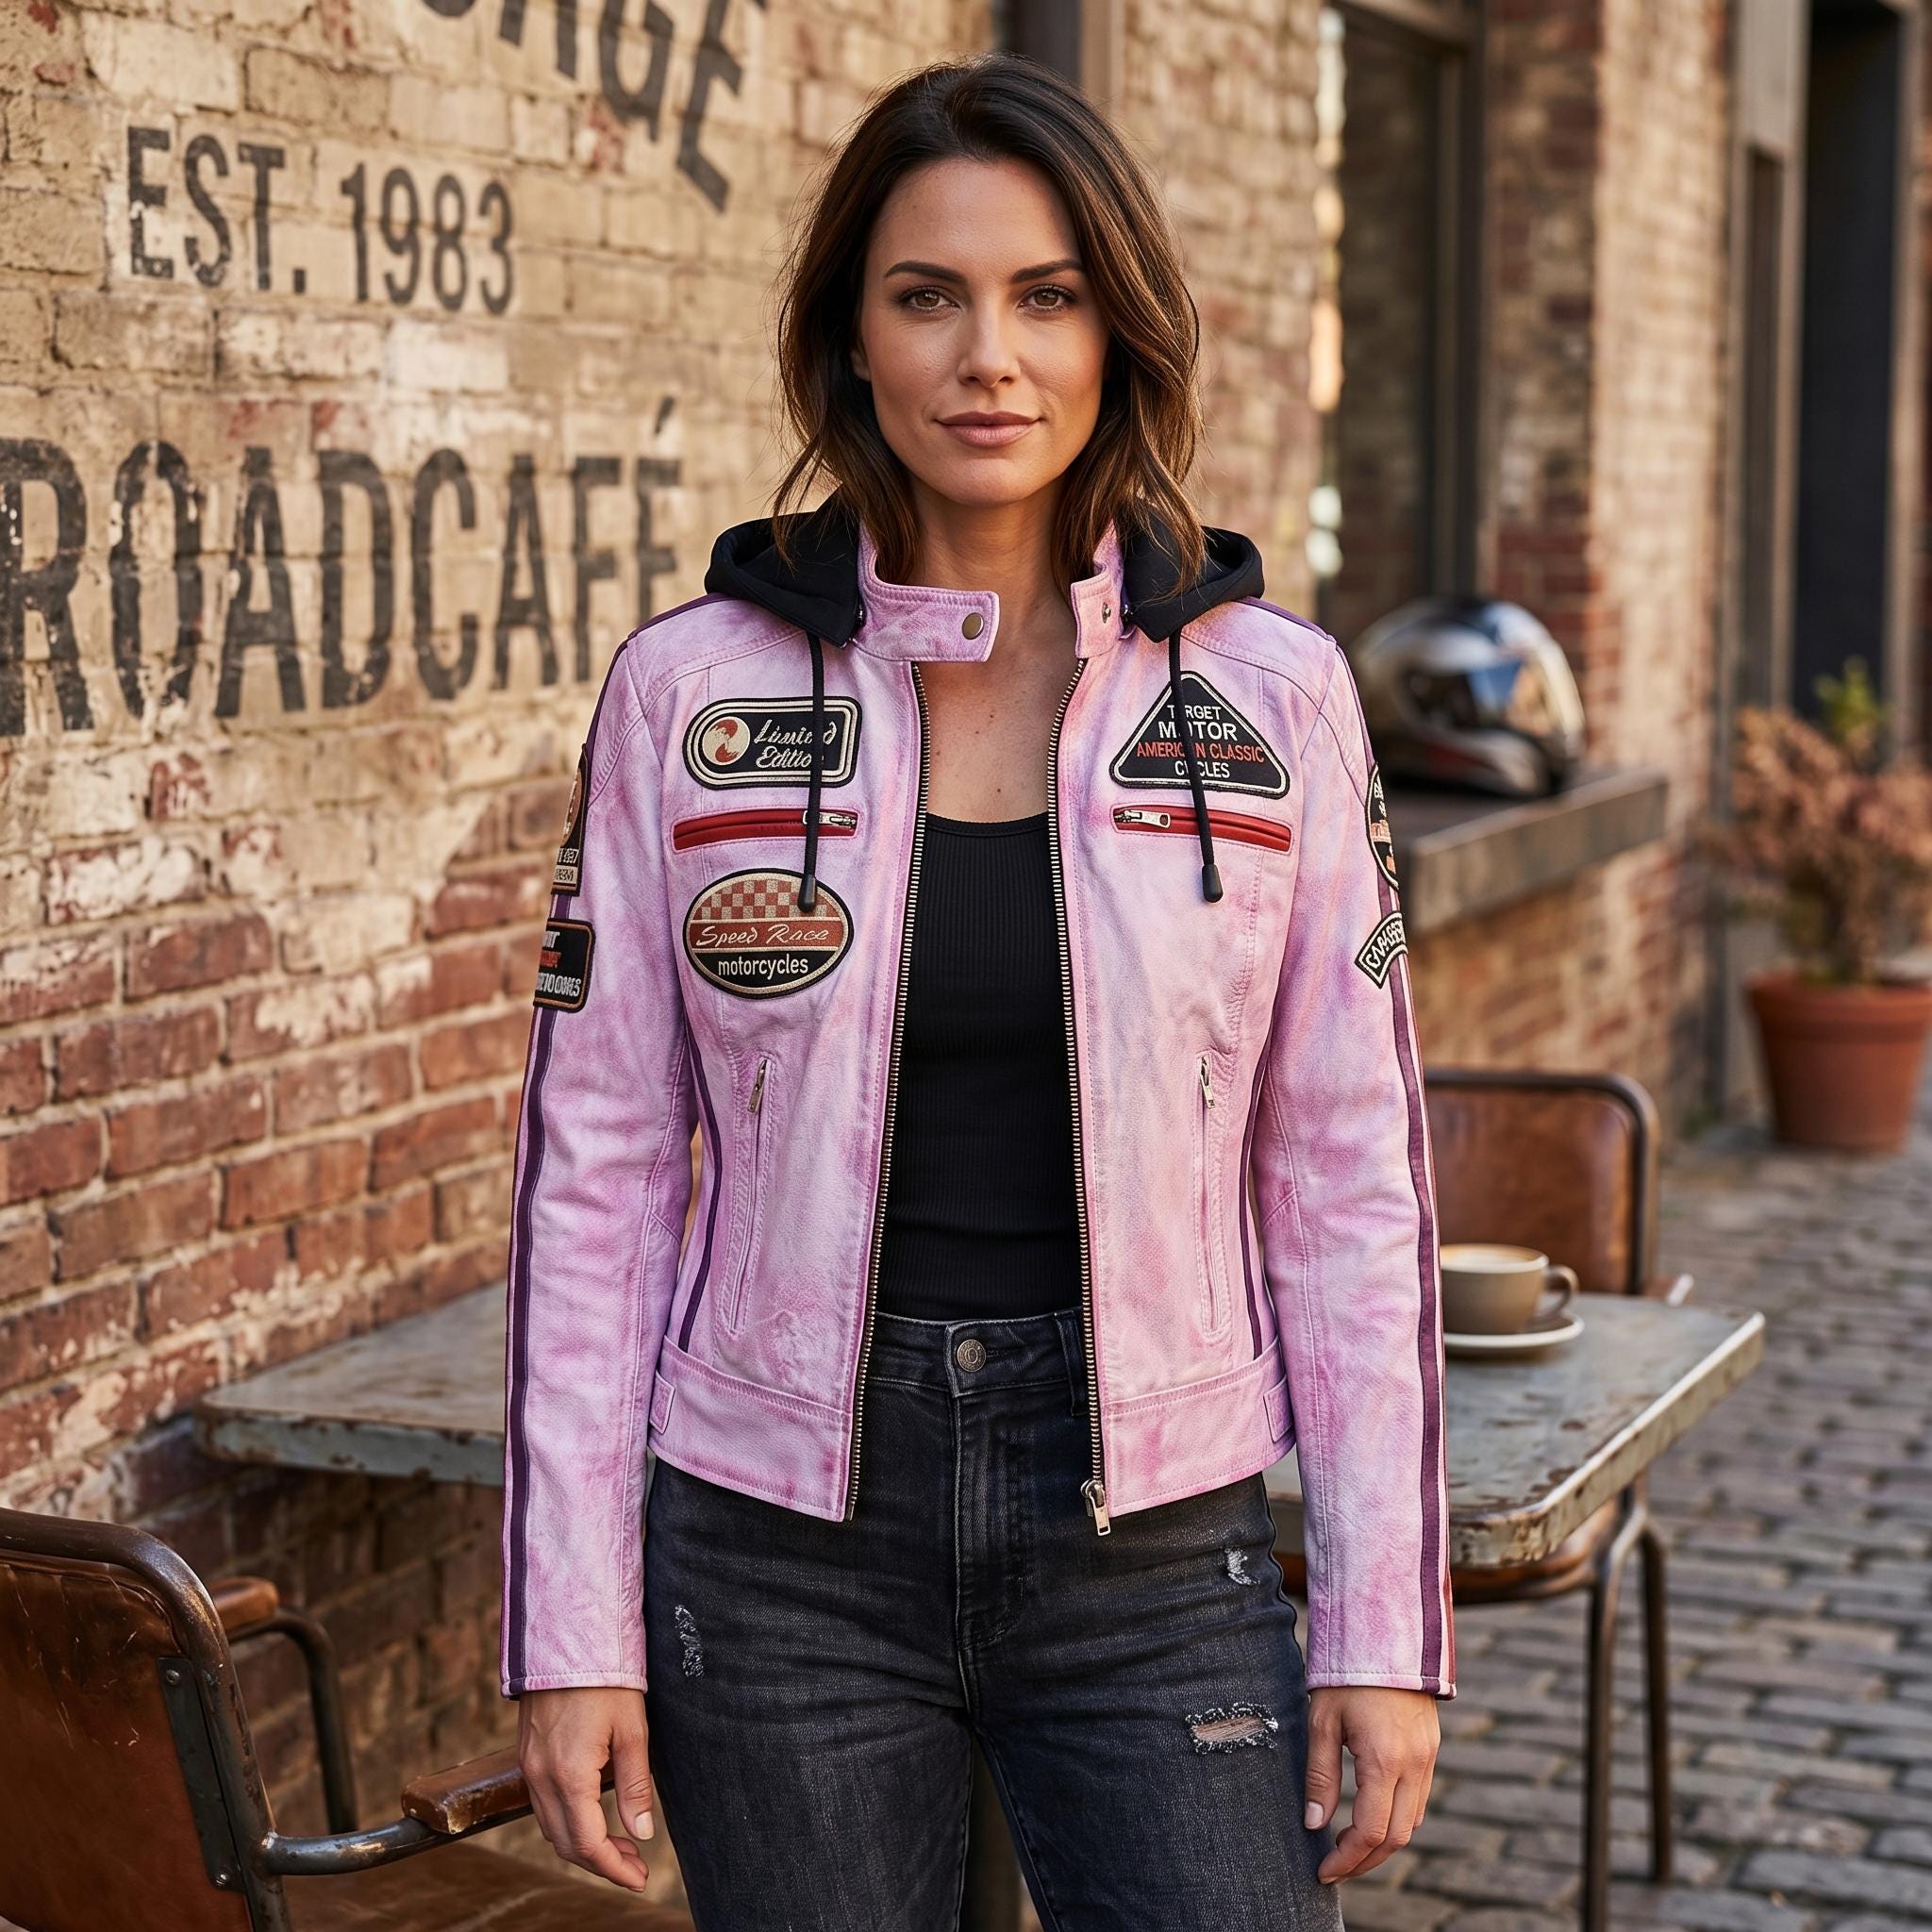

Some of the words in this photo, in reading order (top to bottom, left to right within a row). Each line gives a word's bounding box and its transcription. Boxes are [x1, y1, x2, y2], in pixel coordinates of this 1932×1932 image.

[126, 125, 307, 294] EST.
[340, 161, 515, 316] 1983
[1167, 705, 1222, 721] TRGET
[756, 745, 824, 769] Editio
[1137, 741, 1207, 758] AMERICN
[1209, 742, 1265, 763] CLASSIC
[1174, 760, 1230, 778] CCLES
[696, 925, 758, 948] Speed
[718, 954, 808, 980] motorcycles
